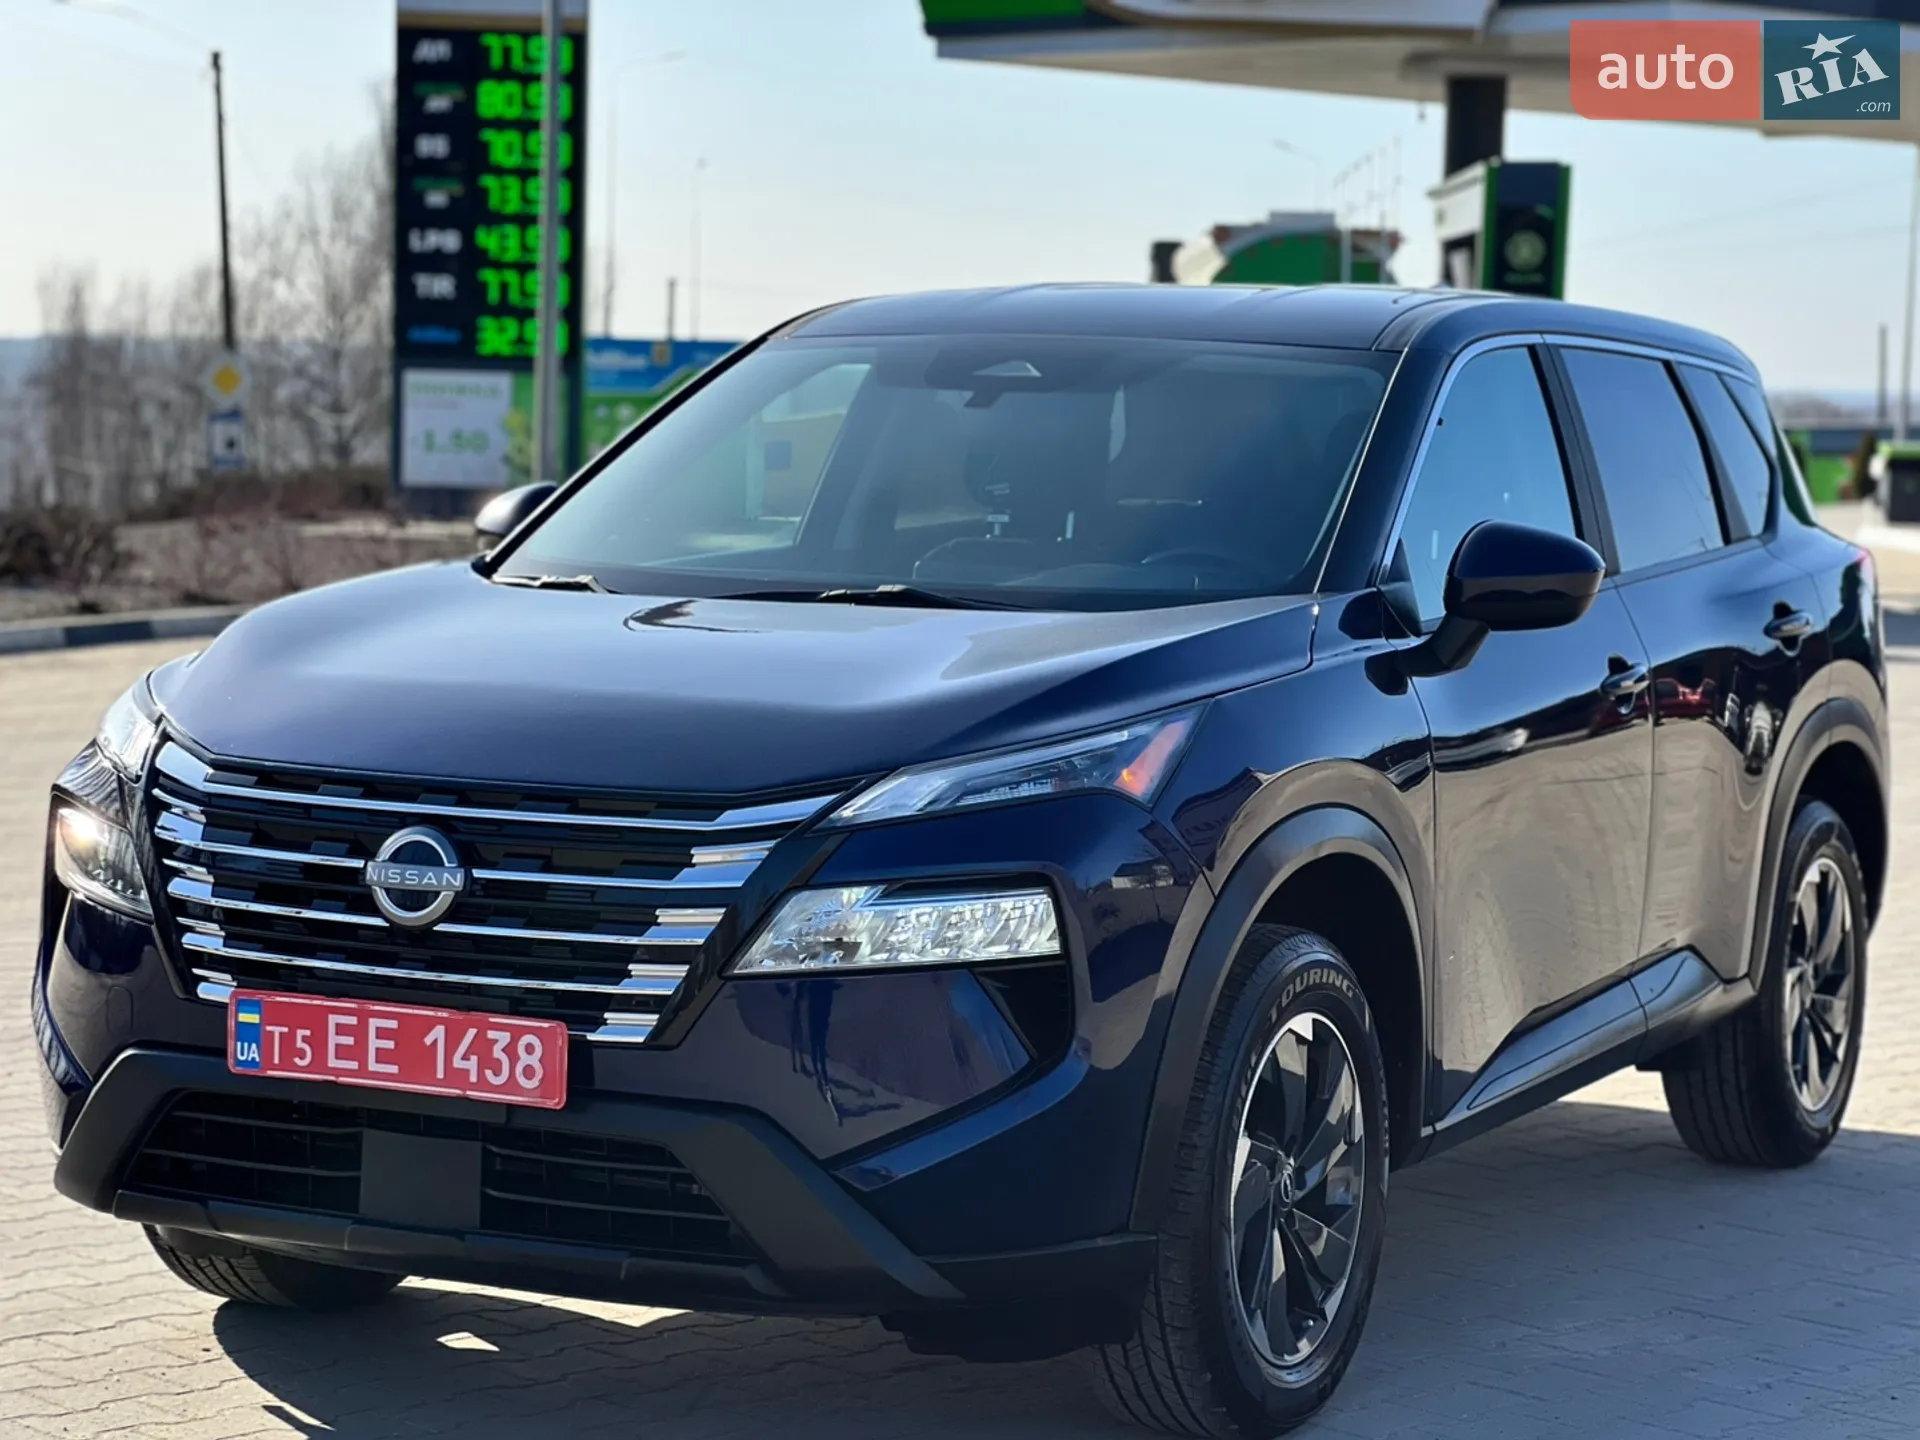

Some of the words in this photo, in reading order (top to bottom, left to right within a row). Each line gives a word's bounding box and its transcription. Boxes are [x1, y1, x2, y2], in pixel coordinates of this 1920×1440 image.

[366, 867, 461, 886] NISSAN
[1268, 968, 1354, 1024] TOURING
[236, 1042, 260, 1062] UA
[327, 1014, 399, 1074] EE
[423, 1025, 544, 1089] 1438
